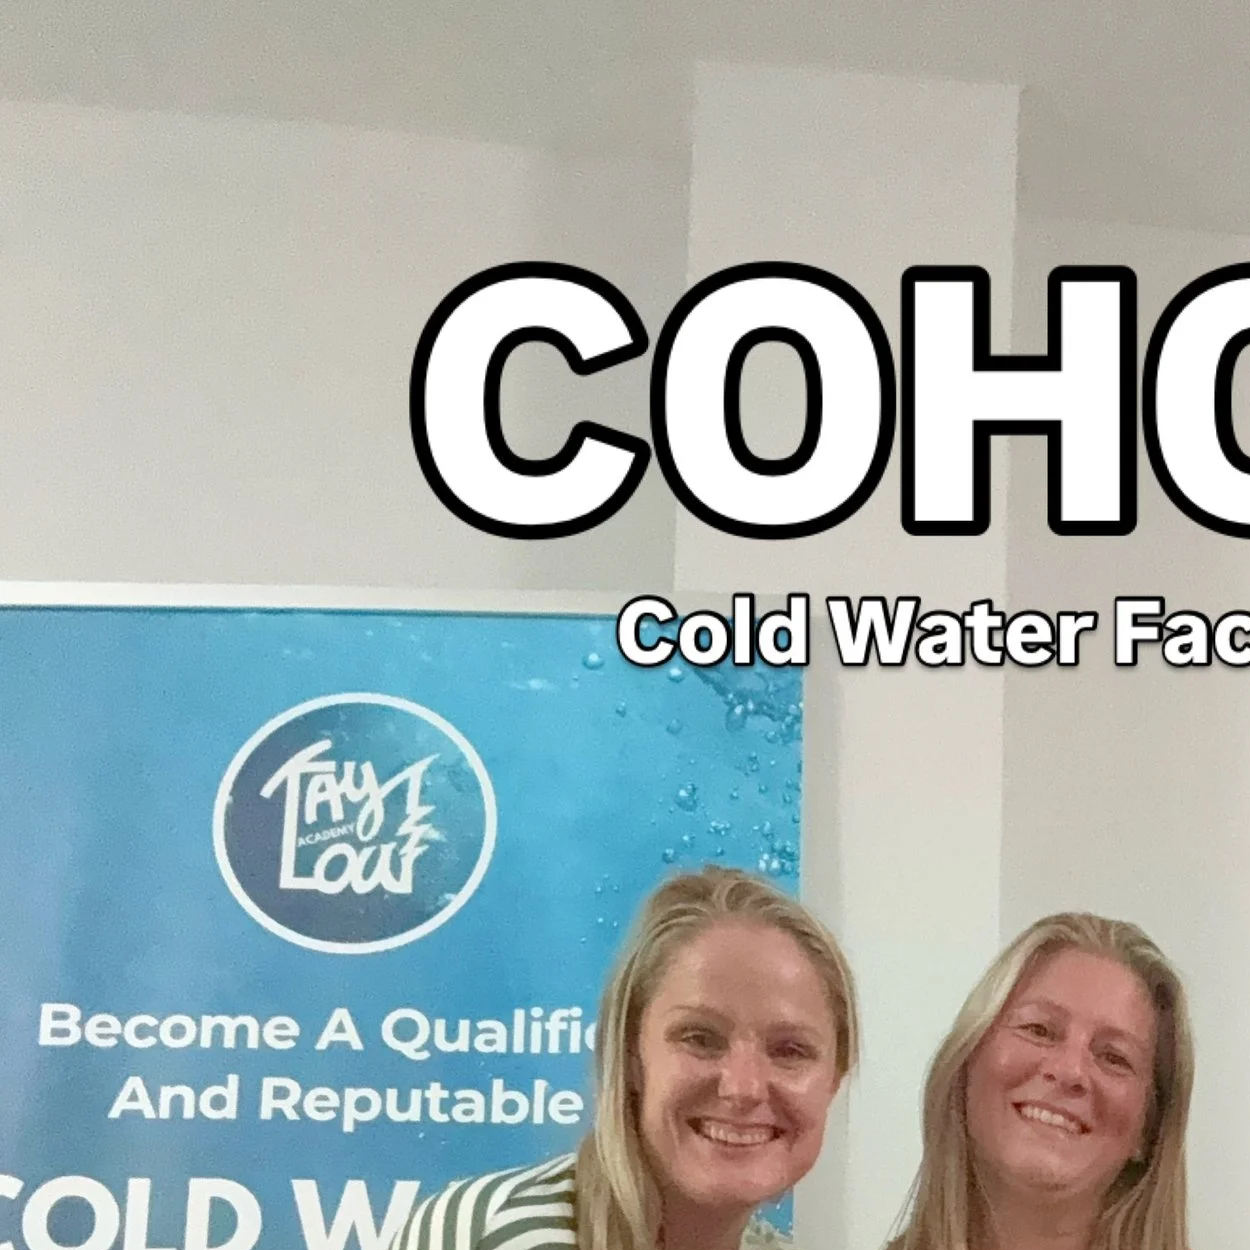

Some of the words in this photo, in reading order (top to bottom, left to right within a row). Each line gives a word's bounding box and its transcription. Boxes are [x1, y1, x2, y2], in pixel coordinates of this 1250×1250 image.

[297, 822, 355, 847] ACADEMY
[38, 1002, 300, 1050] Become
[315, 1008, 364, 1051] A
[108, 1074, 240, 1121] And
[259, 1075, 584, 1133] Reputable
